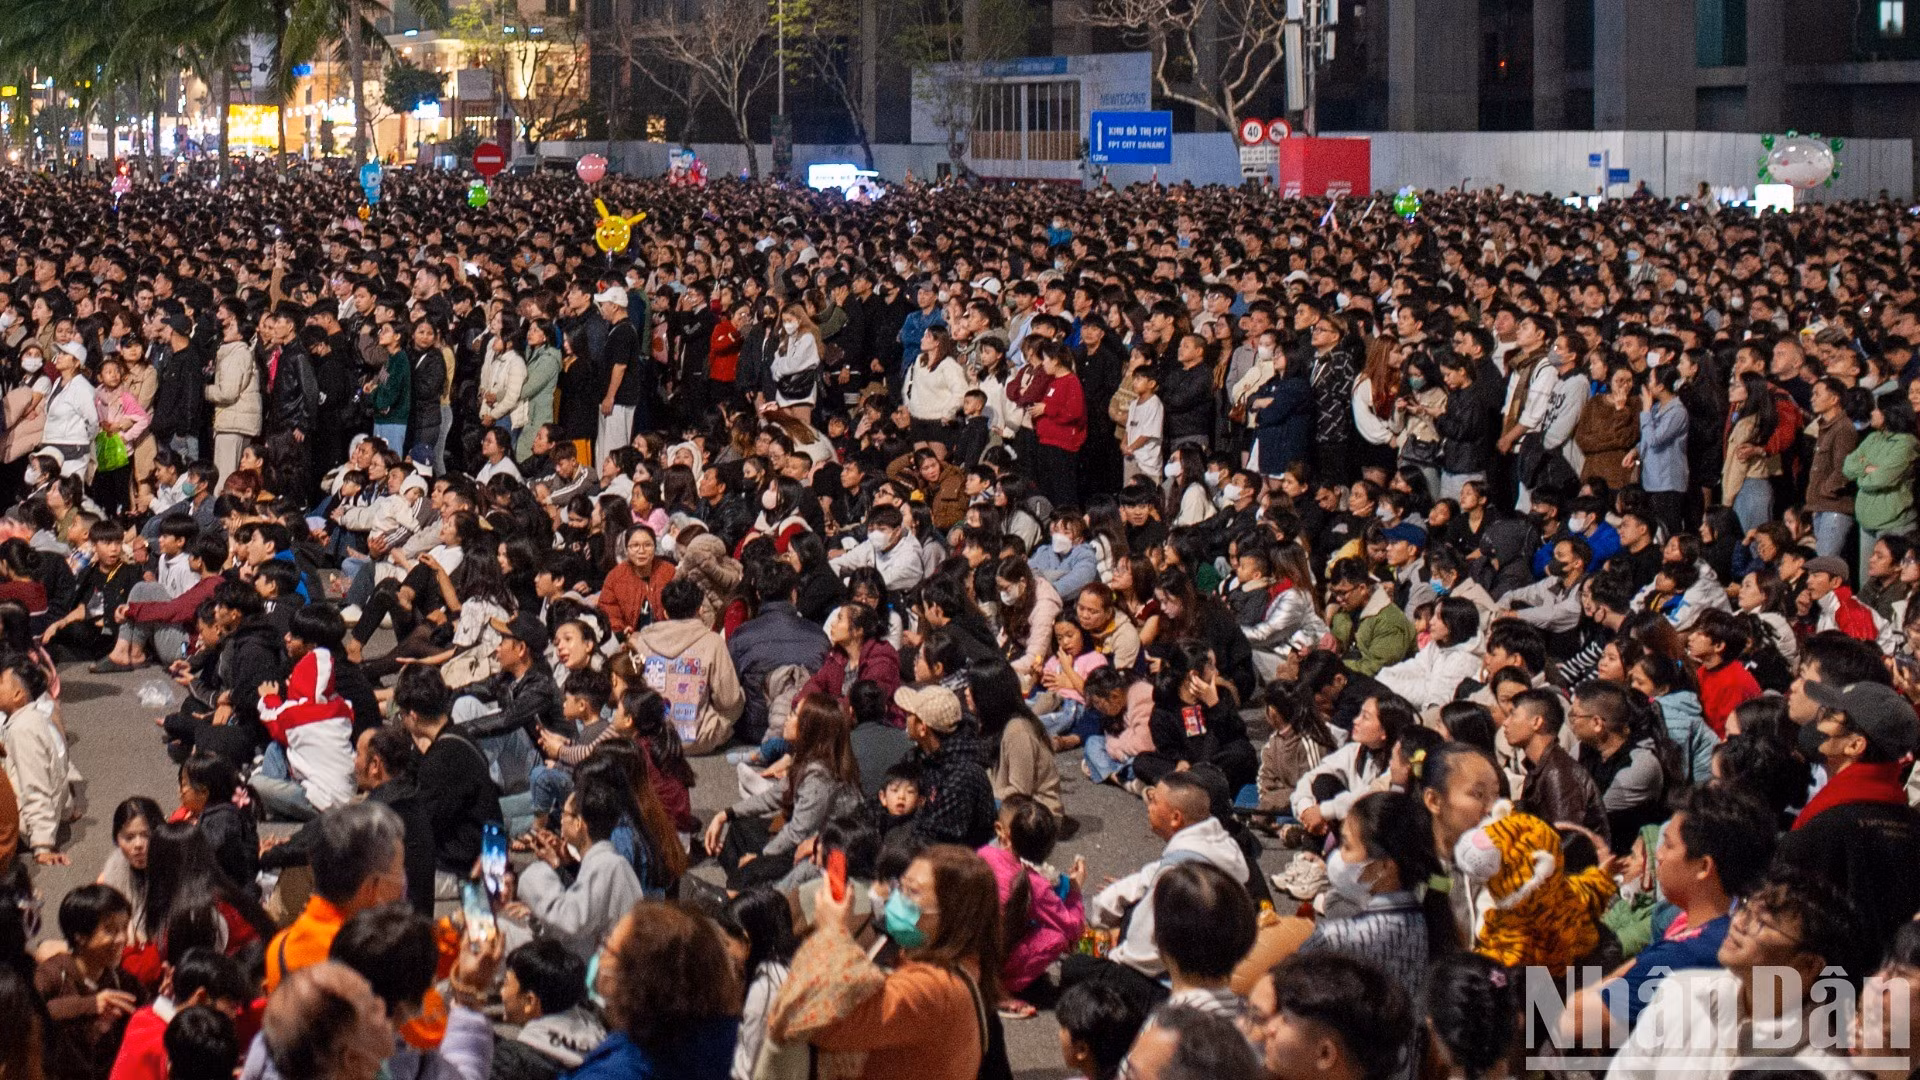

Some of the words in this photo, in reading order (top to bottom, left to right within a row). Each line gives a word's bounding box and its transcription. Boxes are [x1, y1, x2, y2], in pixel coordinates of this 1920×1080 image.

[1108, 127, 1124, 136] KHU
[1153, 127, 1167, 136] FPT
[1248, 126, 1258, 137] 40
[1108, 141, 1120, 149] FPT
[1121, 141, 1136, 149] CITY
[1137, 141, 1165, 149] DANANG
